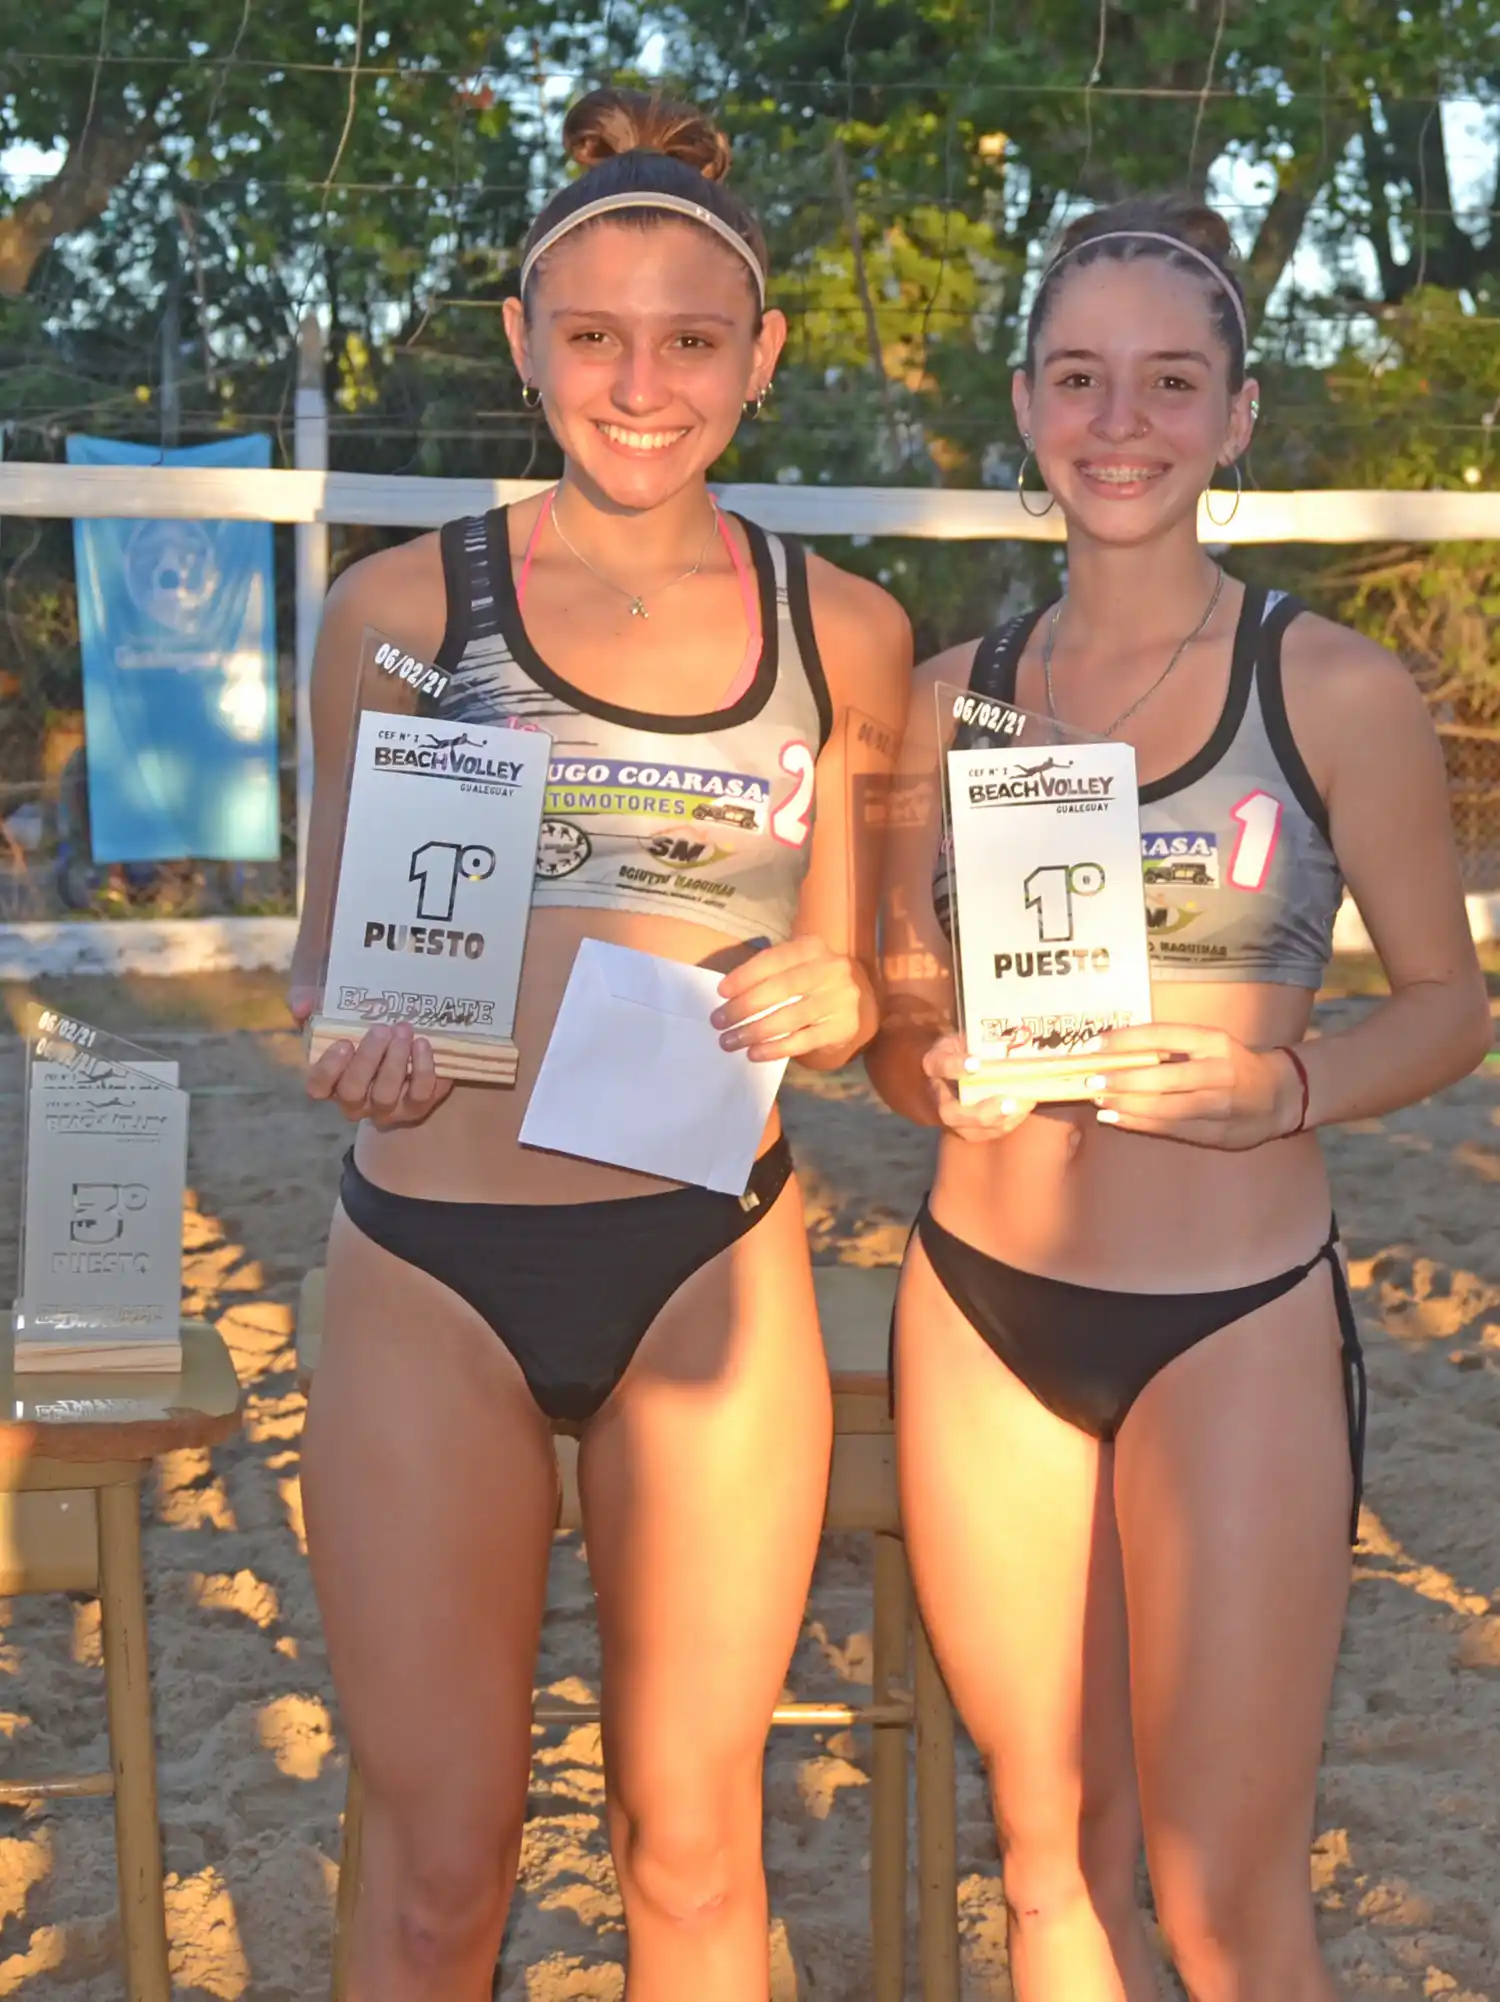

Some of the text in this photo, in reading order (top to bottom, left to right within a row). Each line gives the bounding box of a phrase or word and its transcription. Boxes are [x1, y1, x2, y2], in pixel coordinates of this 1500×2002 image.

[375, 643, 448, 698] 06/02/21
[953, 695, 1027, 737] 06/02/21
[378, 729, 396, 740] CEF
[374, 746, 524, 782] BEACH VOLLEY
[968, 767, 984, 778] CEF
[460, 783, 515, 798] GUALEGUAY
[548, 763, 764, 803] UGO COARASA
[769, 739, 815, 849] 2
[969, 775, 1114, 804] BEACH VOLLEY
[543, 792, 686, 816] TOMOTORES
[1056, 802, 1109, 814] GUALEGUAY
[648, 836, 706, 862] SM
[1226, 788, 1284, 893] 1
[363, 921, 485, 960] PUESTO
[994, 948, 1110, 979] PUESTO
[381, 990, 495, 1025] DEBATE
[38, 1011, 96, 1047] 06/02/21
